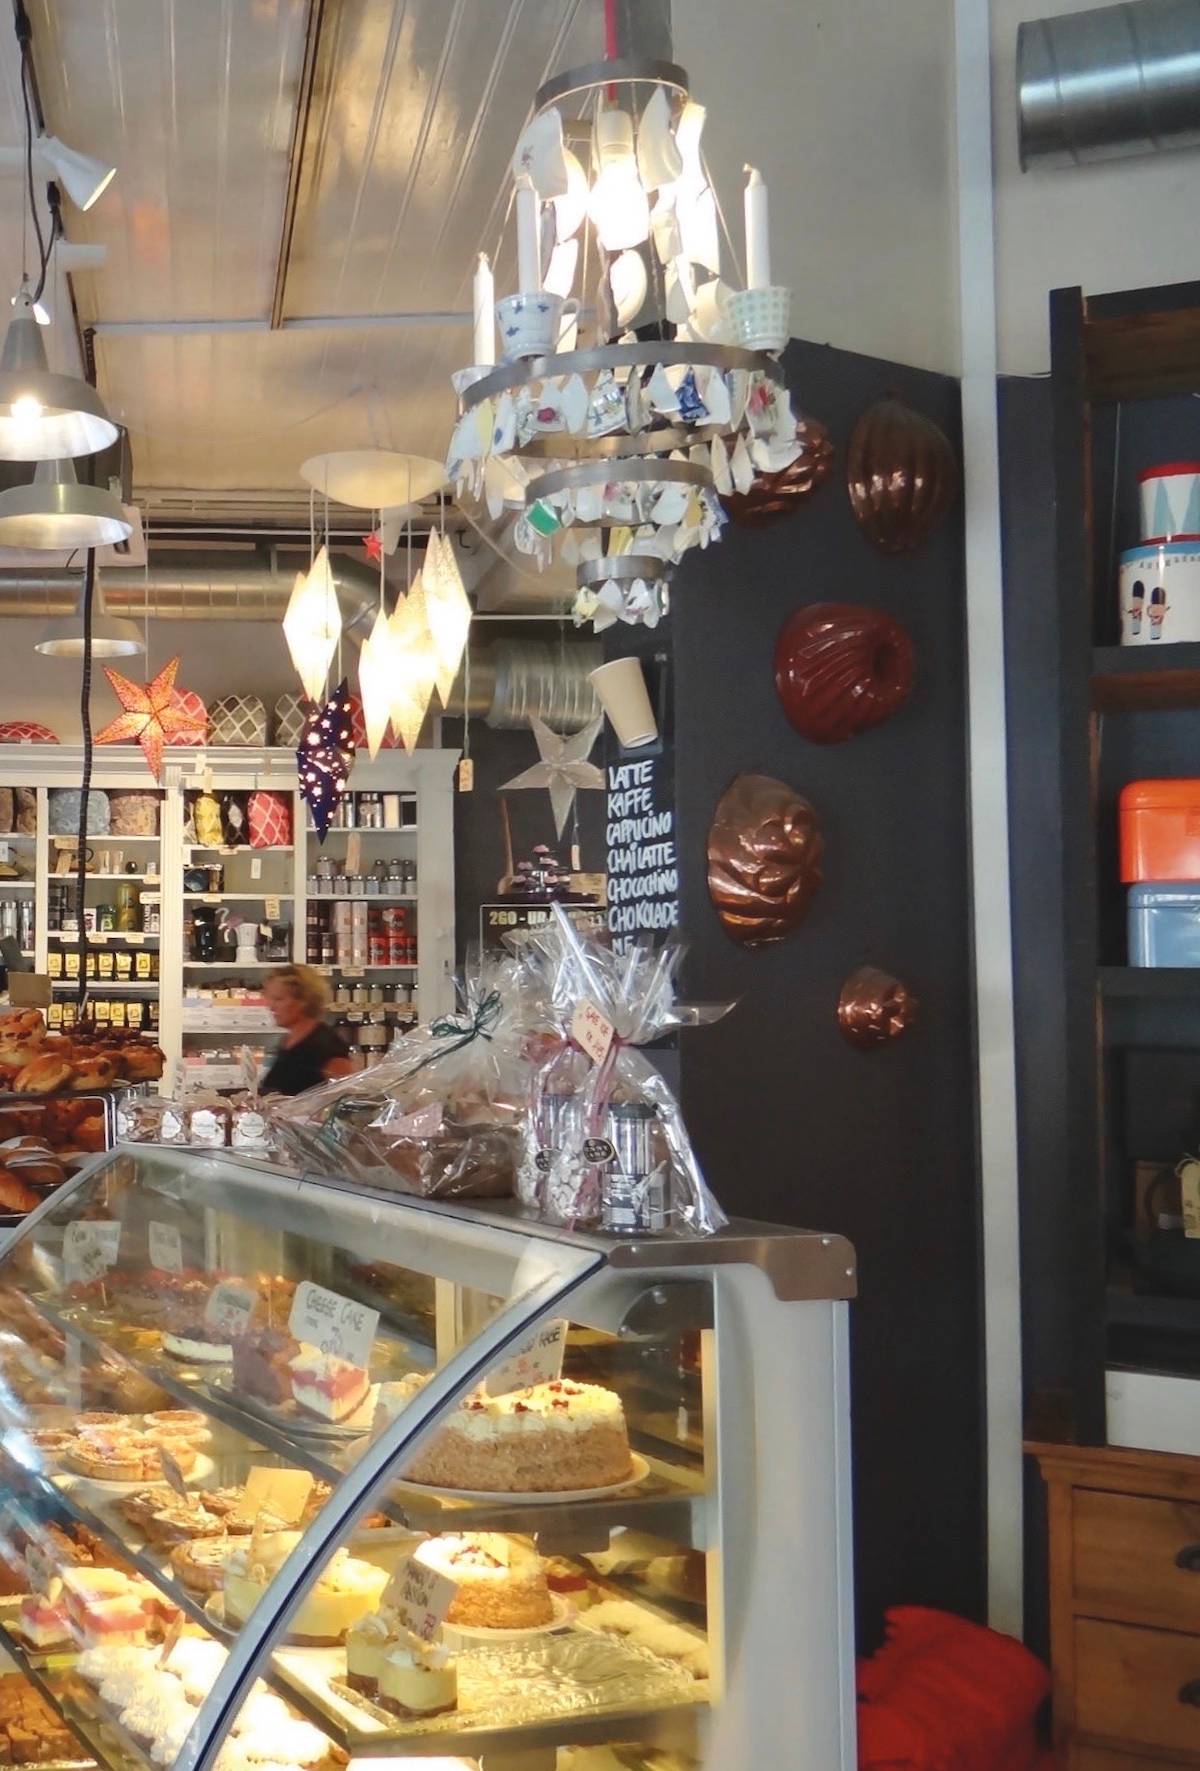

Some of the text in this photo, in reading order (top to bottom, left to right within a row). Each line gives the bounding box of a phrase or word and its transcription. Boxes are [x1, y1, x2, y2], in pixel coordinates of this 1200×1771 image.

[609, 760, 654, 790] LATTE
[607, 787, 654, 819] KAFFE
[608, 900, 679, 932] CHOKOLADE
